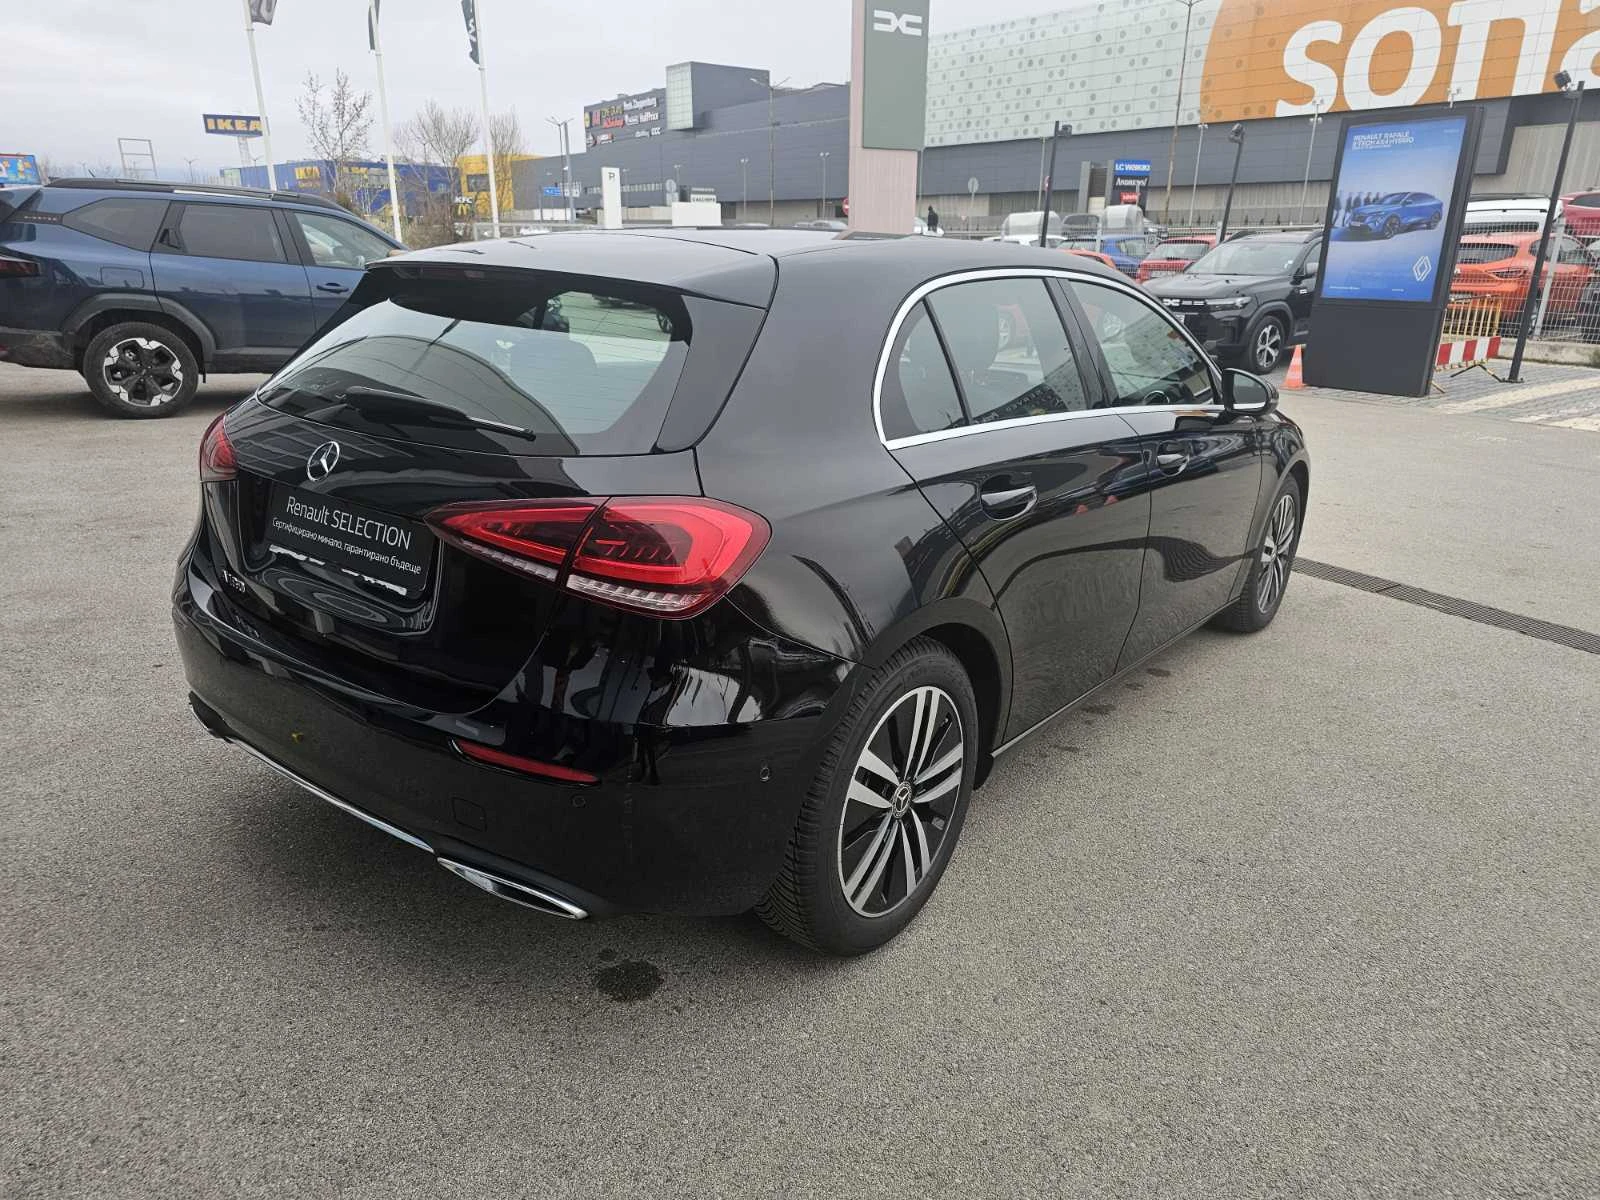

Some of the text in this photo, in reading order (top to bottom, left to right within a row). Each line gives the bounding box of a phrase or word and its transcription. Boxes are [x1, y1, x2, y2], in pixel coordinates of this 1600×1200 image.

[206, 119, 262, 131] IKEA
[272, 517, 422, 575] Сертифицирано минало, гарантирано бъдеще
[286, 495, 412, 551] Renault SELECTION
